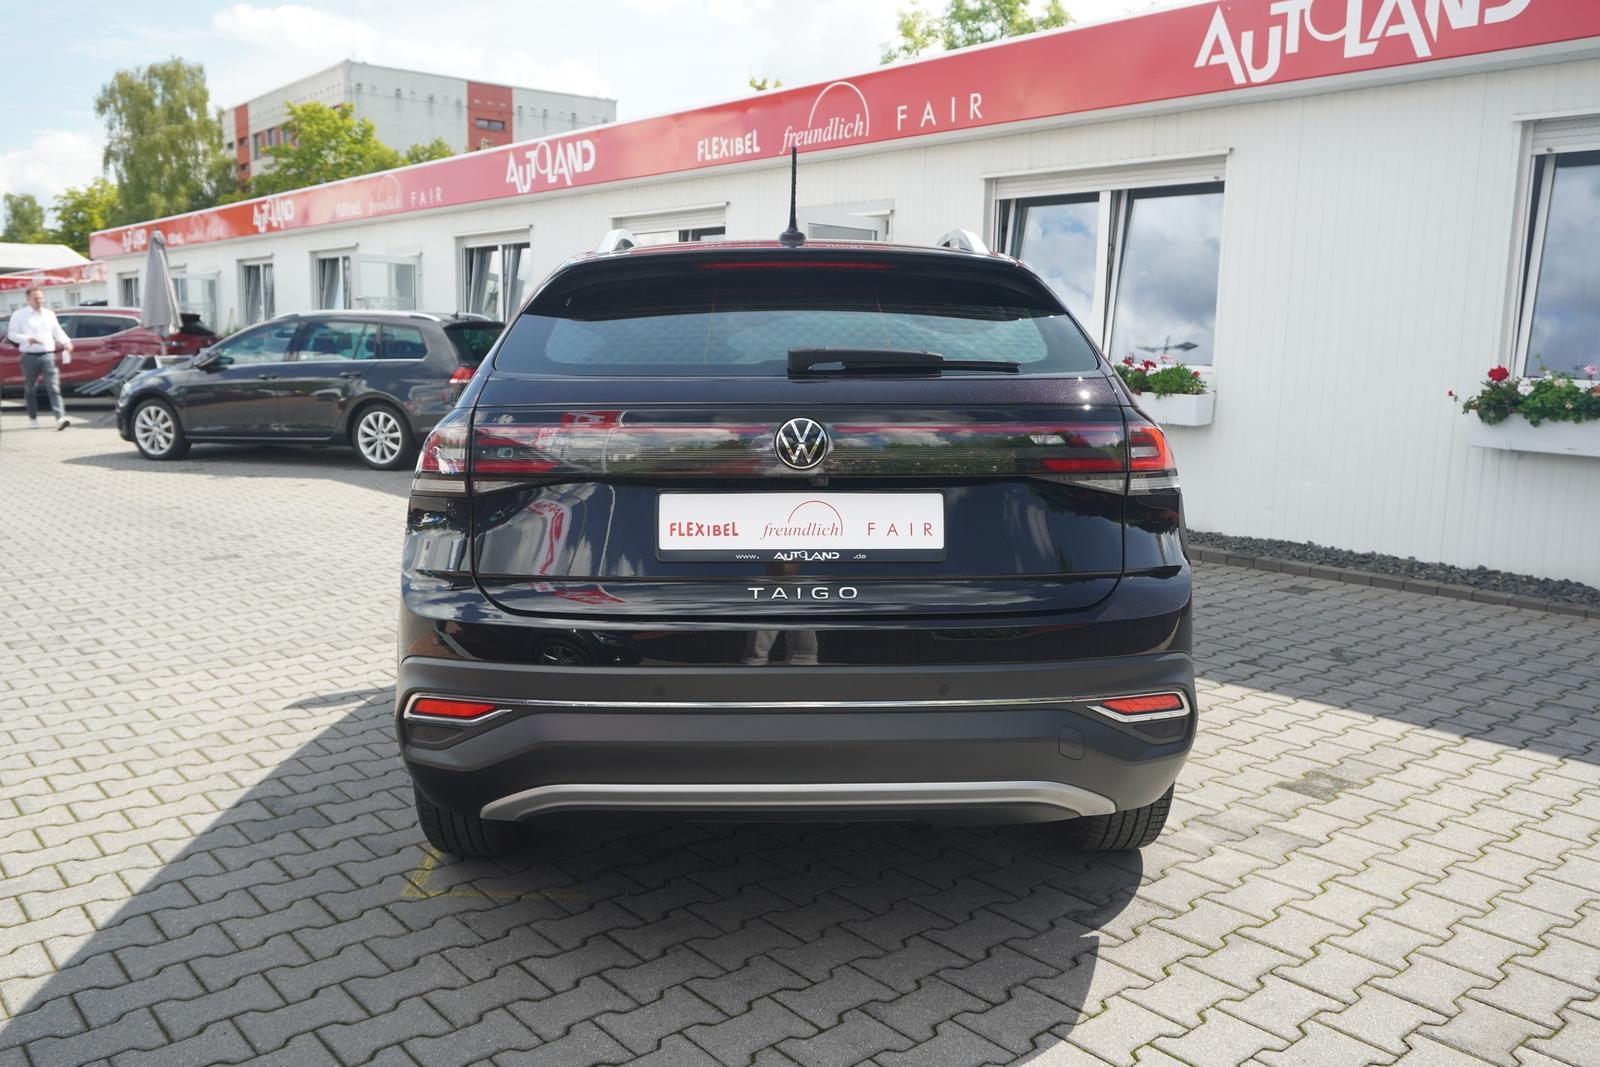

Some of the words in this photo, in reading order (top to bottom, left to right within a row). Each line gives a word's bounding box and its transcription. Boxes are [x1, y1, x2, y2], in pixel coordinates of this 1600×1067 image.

[697, 129, 761, 162] FLEXIBEL
[779, 113, 864, 154] freundlich
[896, 92, 983, 131] FAIR
[505, 139, 597, 194] AUTOLAND
[669, 521, 739, 537] FLEXIBEL
[760, 522, 840, 540] freundlich
[867, 522, 933, 537] FAIR
[773, 550, 840, 561] AUTOLAND
[747, 586, 859, 600] TAIGO
